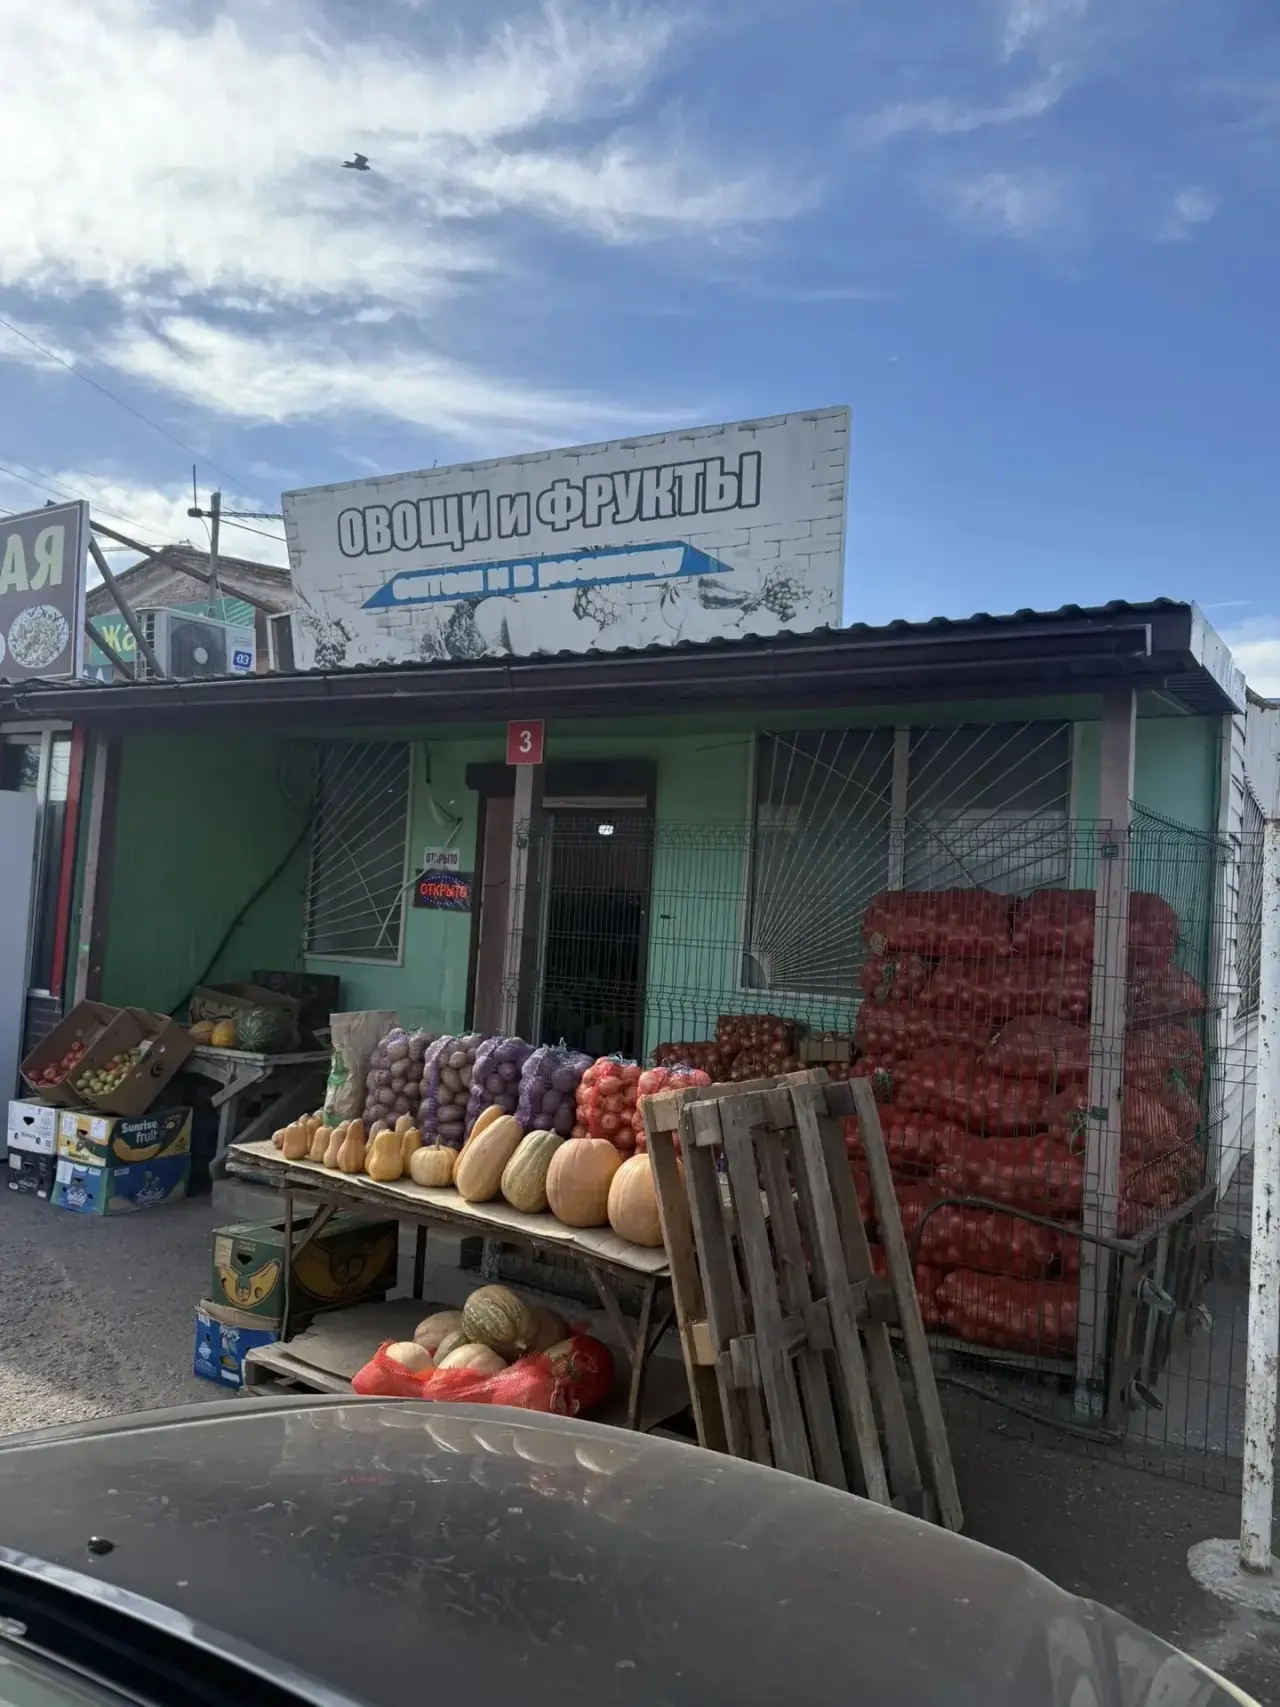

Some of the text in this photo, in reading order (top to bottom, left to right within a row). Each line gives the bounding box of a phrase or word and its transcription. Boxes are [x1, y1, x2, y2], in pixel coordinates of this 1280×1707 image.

[338, 490, 491, 558] ОВОЩИ
[536, 450, 763, 532] ФРУКТЫ
[519, 730, 533, 753] 3
[420, 883, 467, 899] ОТКРЫТО
[121, 1120, 158, 1134] Sunrise
[136, 1130, 158, 1144] fruit
